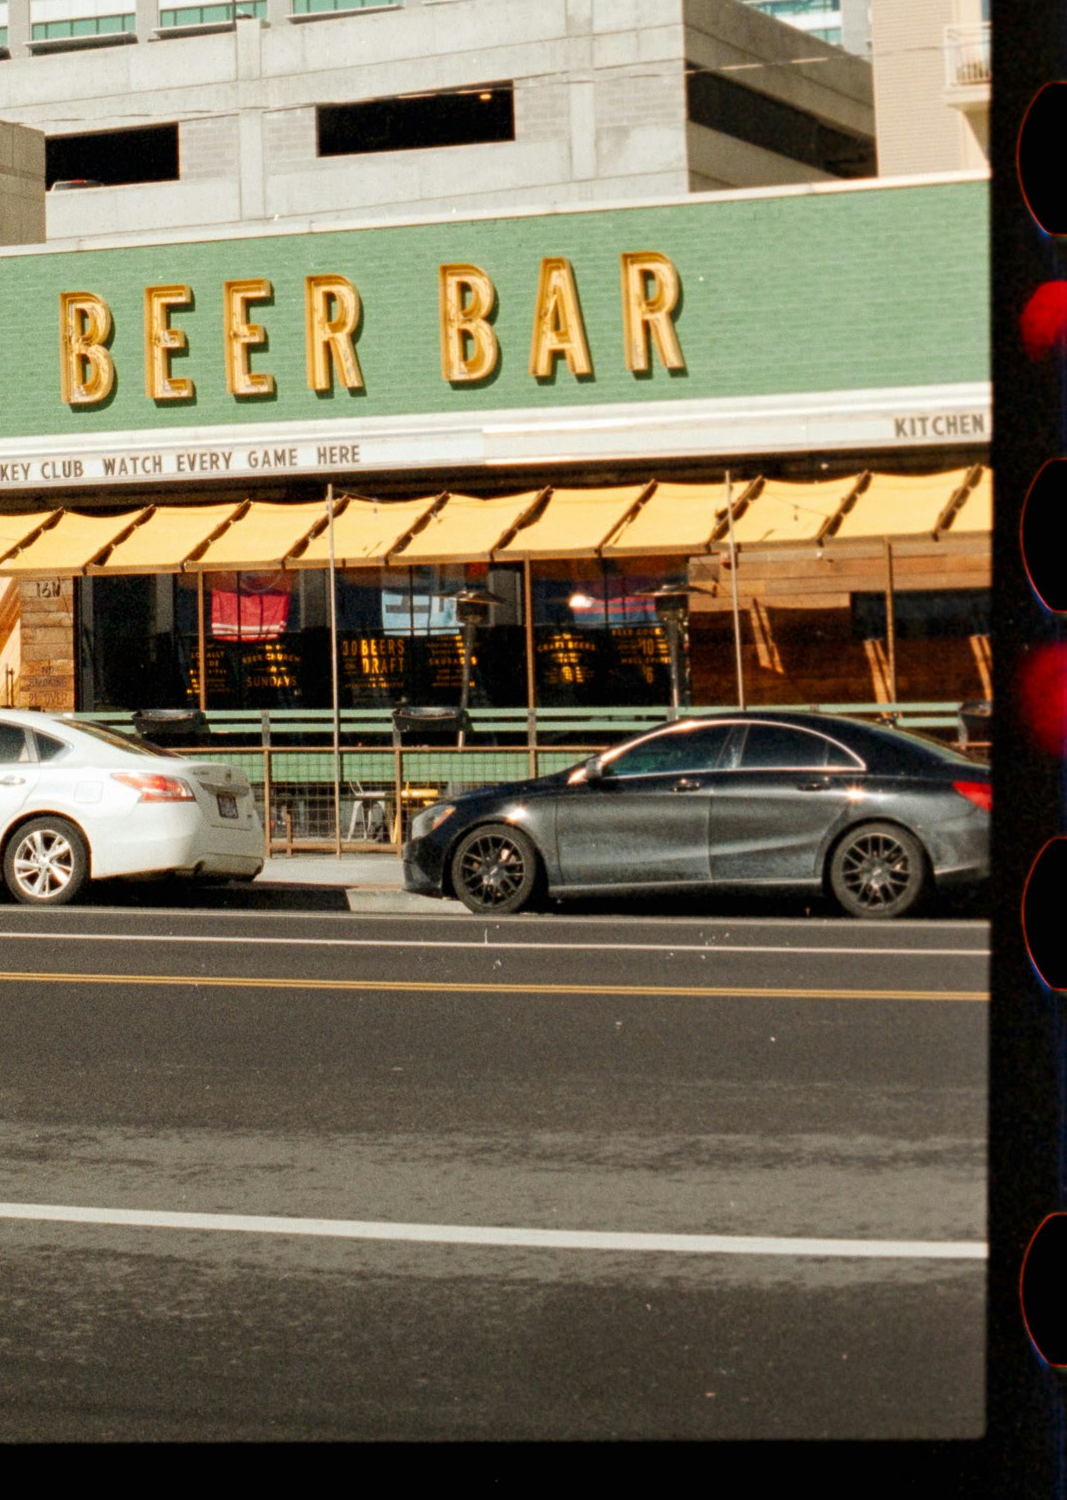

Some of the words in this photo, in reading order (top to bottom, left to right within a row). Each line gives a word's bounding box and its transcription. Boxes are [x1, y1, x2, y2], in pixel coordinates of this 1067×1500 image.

[59, 274, 366, 405] BEER
[437, 251, 686, 383] BAR
[894, 413, 985, 438] KITCHEN
[41, 459, 84, 480] CLUB
[103, 454, 163, 476] WATCH
[177, 451, 233, 472] EVERY
[248, 448, 298, 468] GAME
[317, 444, 361, 465] HERE
[342, 640, 357, 656] 30
[361, 638, 405, 656] BEERS
[362, 657, 404, 674] DRAFT
[246, 676, 297, 688] SUNDAYS
